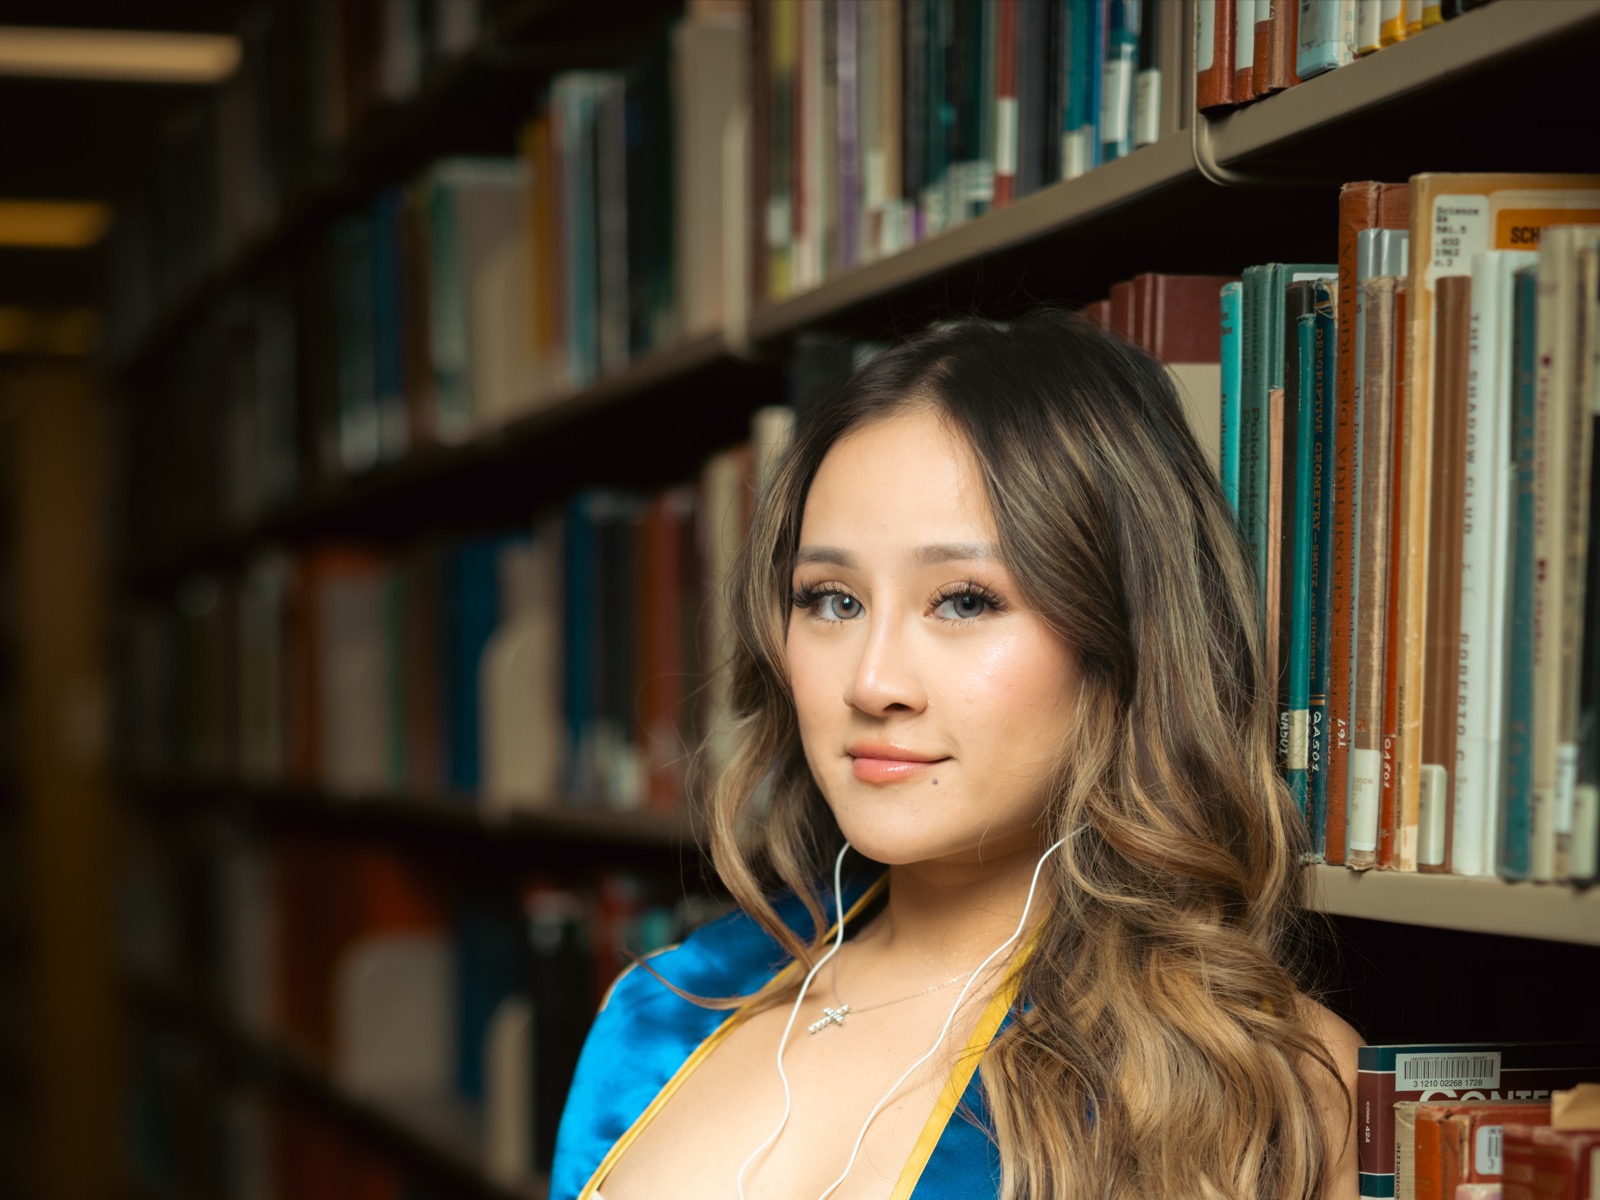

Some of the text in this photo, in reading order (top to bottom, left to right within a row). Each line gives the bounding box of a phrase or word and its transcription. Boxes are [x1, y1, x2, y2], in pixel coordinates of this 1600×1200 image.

[1338, 241, 1351, 427] DESCRIPTIVA
[1314, 327, 1324, 435] DESCRIPTIVE
[1353, 382, 1361, 416] The
[1352, 422, 1360, 495] Random
[1333, 446, 1347, 613] GEOMETRIA
[1309, 616, 1317, 681] GINGRICH
[1311, 711, 1322, 773] QA501
[1383, 738, 1391, 790] QA501
[1465, 1079, 1483, 1087] 1728
